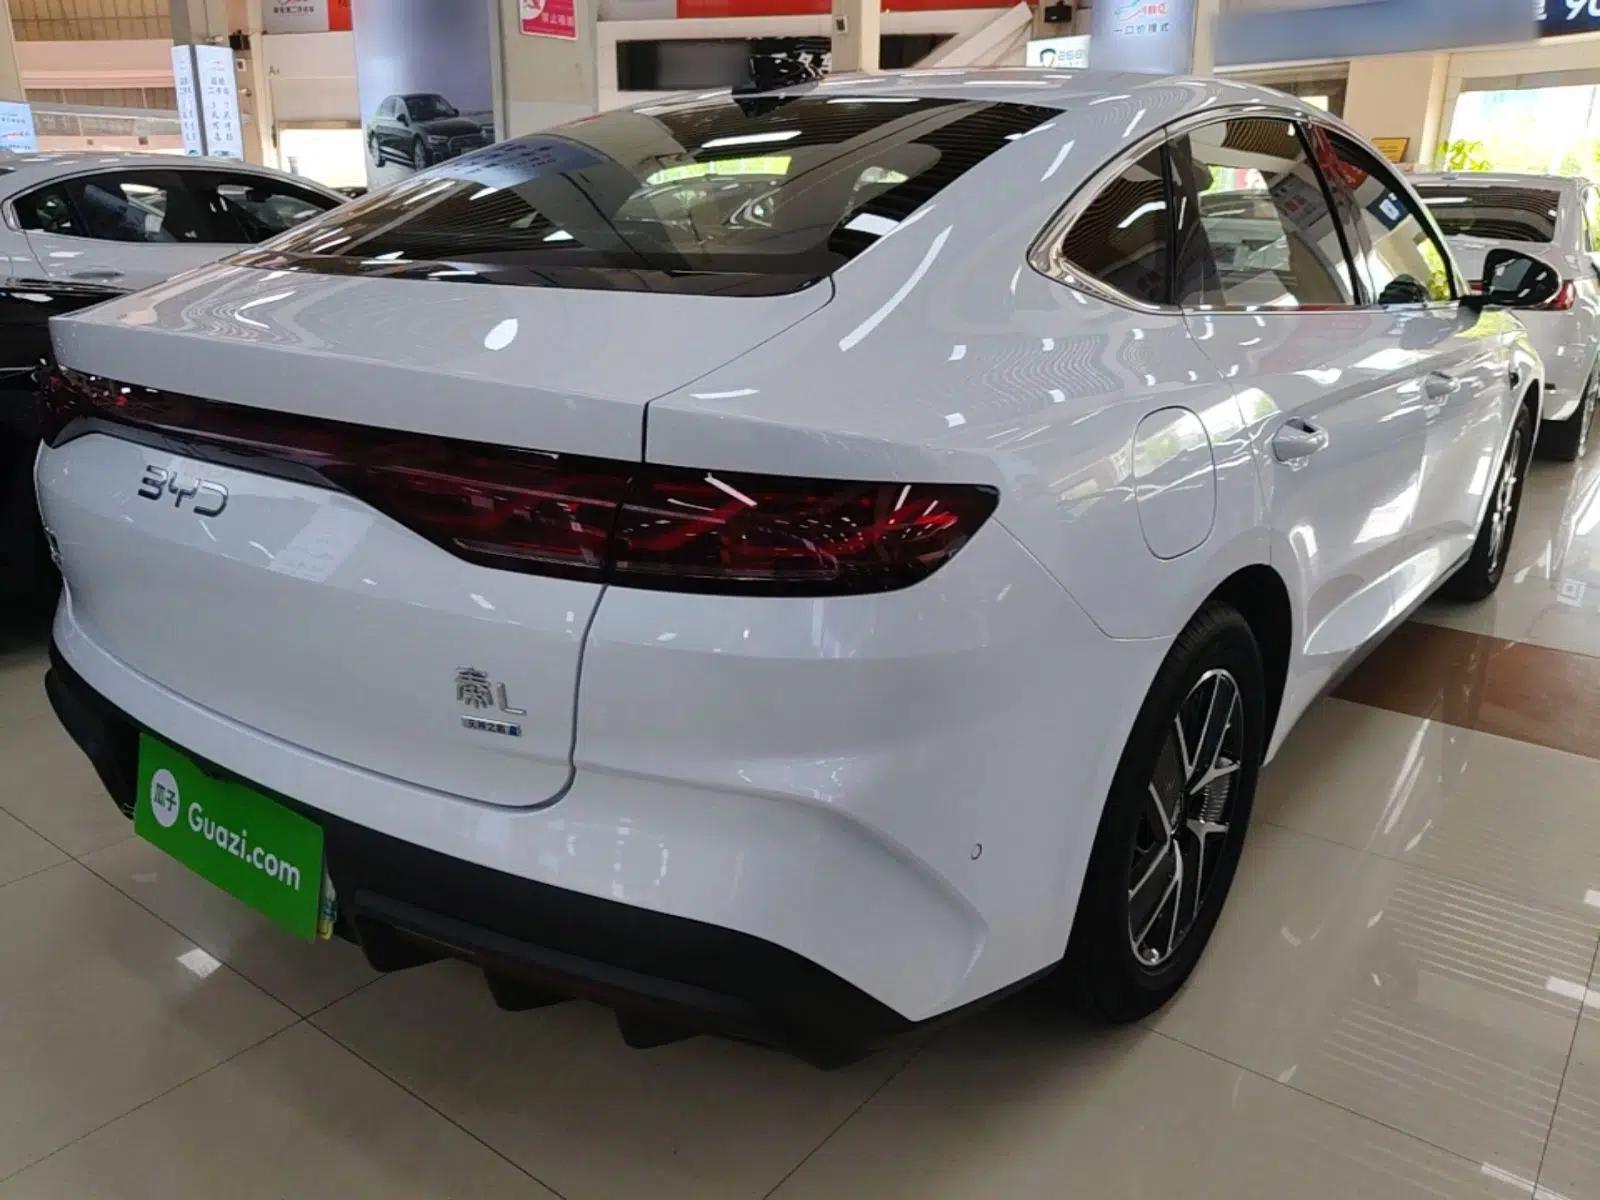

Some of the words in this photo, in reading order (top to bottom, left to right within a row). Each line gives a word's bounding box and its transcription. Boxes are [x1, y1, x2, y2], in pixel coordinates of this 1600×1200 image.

[138, 464, 229, 518] BYD
[153, 782, 178, 812] 瓜子
[188, 802, 300, 891] Guazi.com
